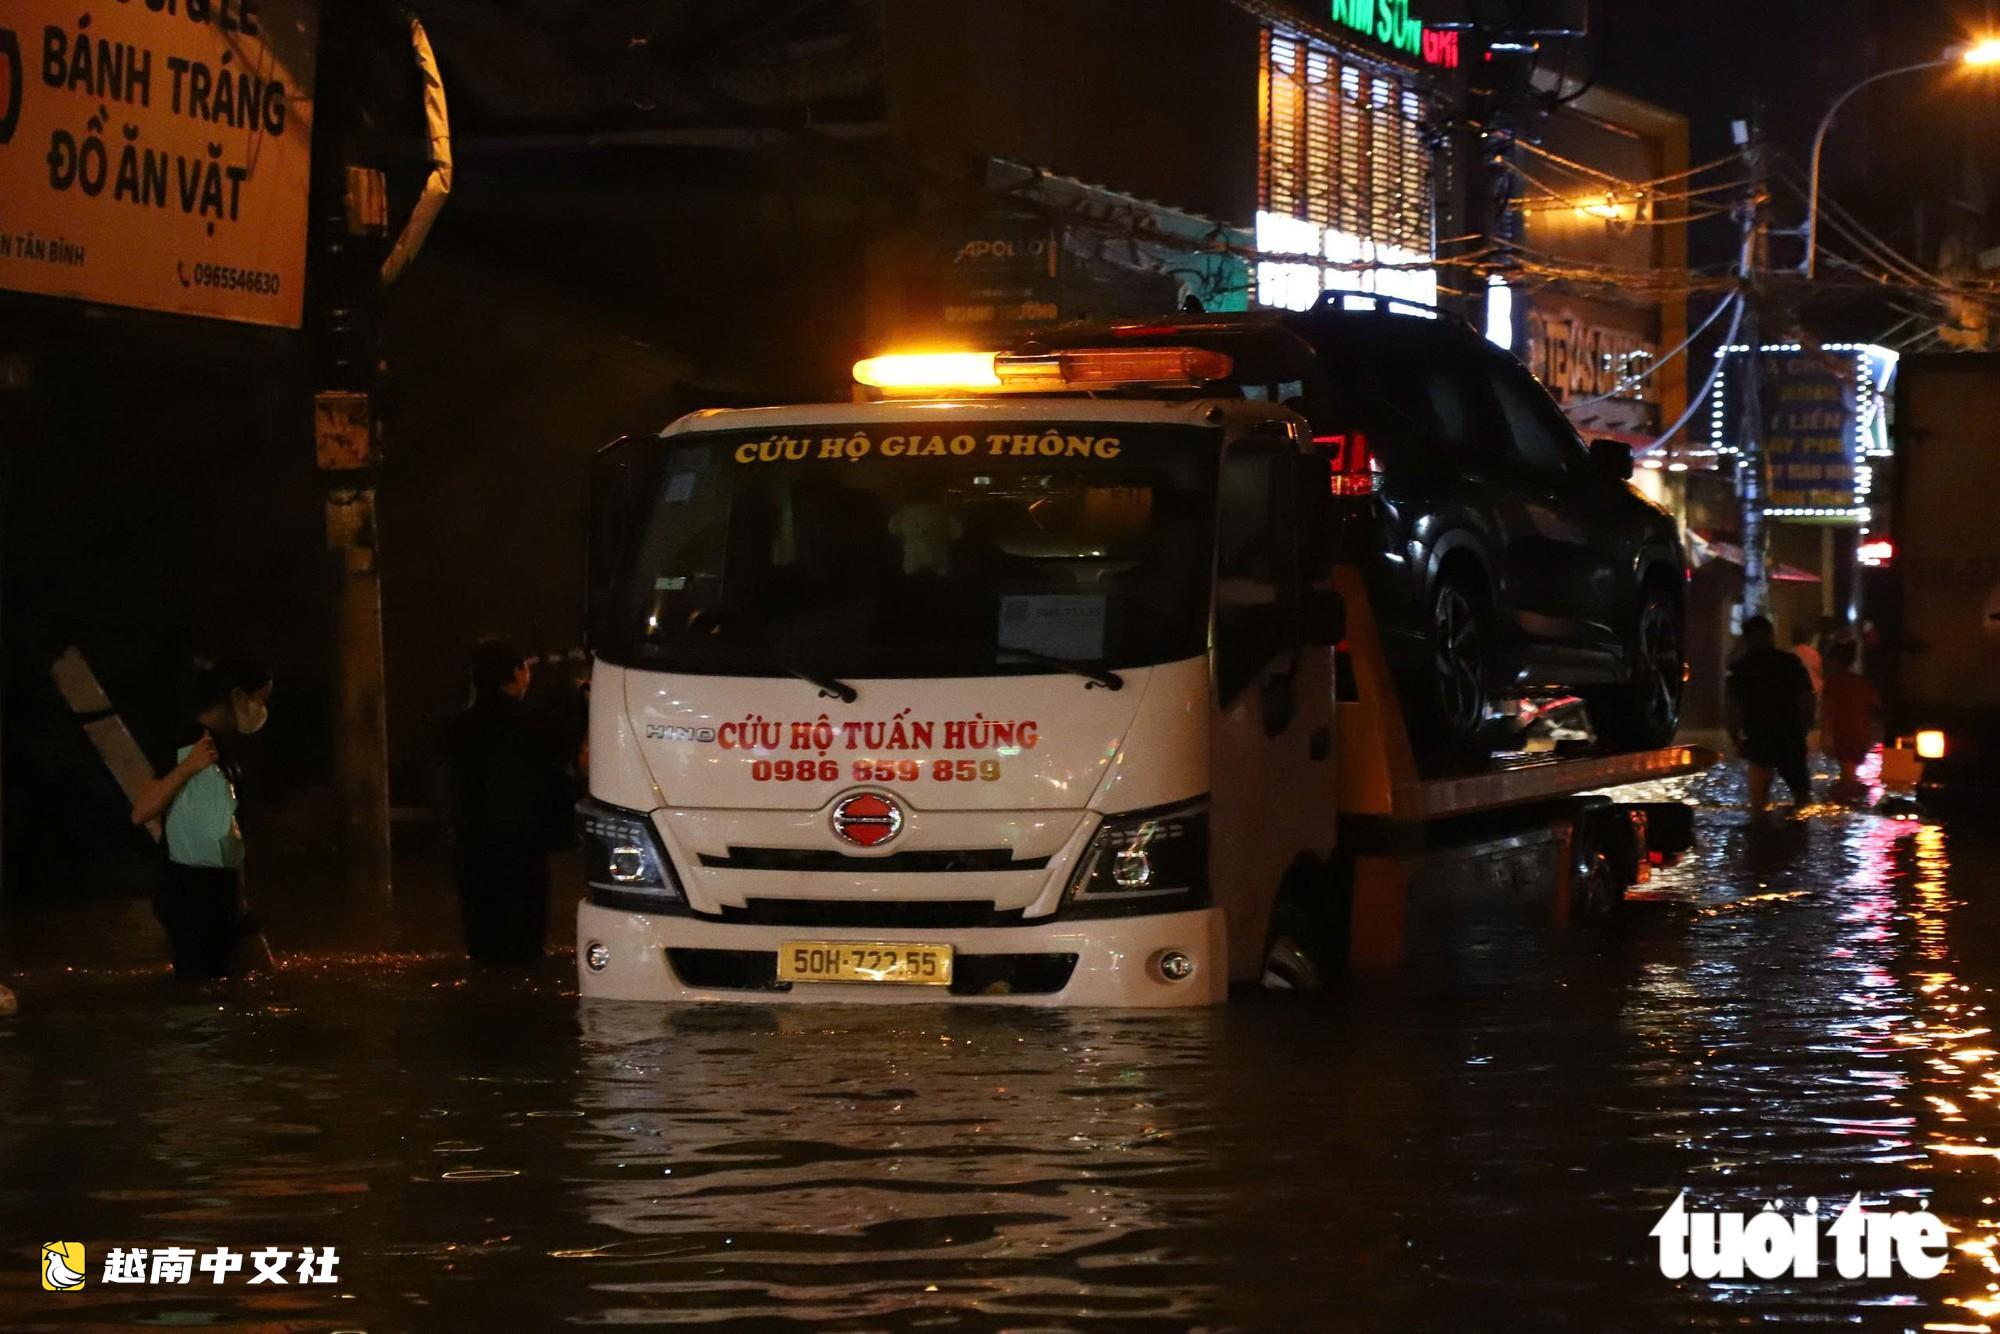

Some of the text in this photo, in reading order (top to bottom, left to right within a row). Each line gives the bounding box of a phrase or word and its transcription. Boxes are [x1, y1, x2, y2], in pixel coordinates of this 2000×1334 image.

[42, 12, 287, 137] BÁNH TRÁNG
[47, 104, 248, 238] ĐỒ ĂN VẶT
[15, 231, 46, 262] TÂN
[49, 236, 86, 267] BÌNH
[194, 263, 281, 296] 0965546630
[734, 429, 1122, 464] CỨU HỘ GIAO THÔNG
[646, 724, 715, 743] HINO
[717, 707, 1040, 757] CỨU HỘ TUẤN HÙNG
[751, 759, 1002, 783] 0986 859 859
